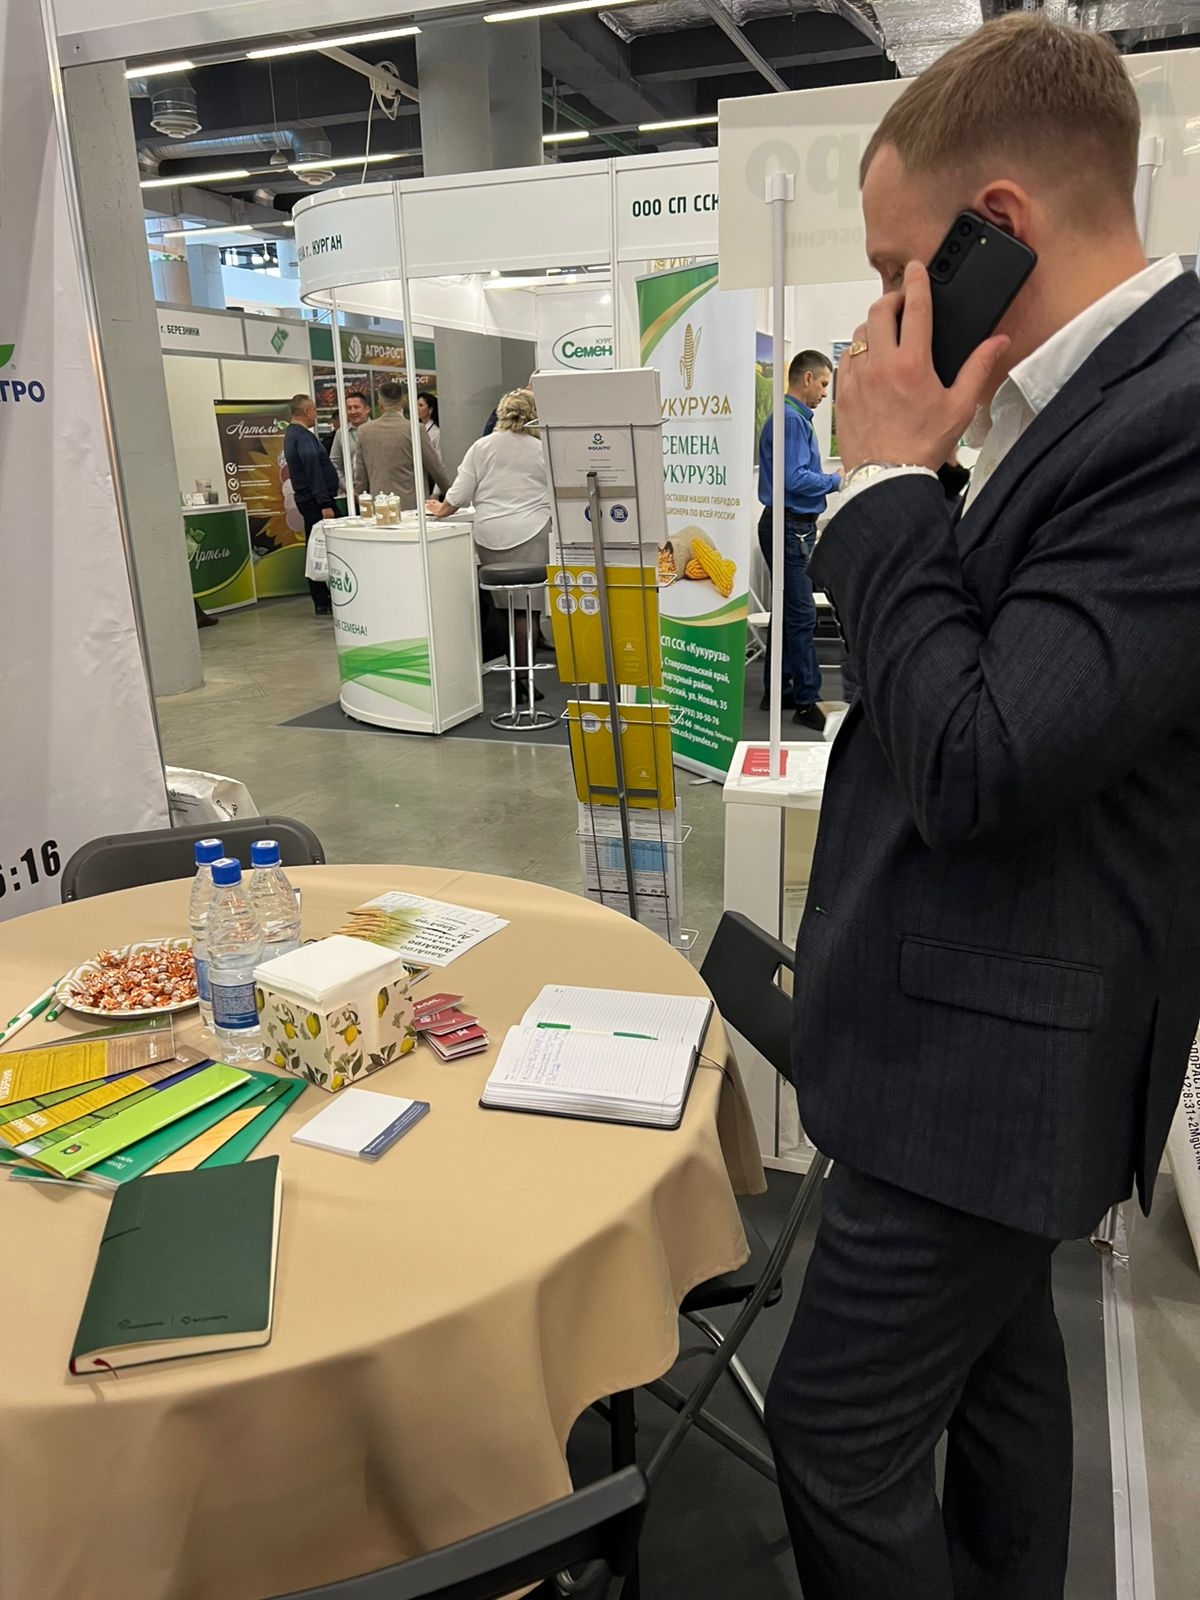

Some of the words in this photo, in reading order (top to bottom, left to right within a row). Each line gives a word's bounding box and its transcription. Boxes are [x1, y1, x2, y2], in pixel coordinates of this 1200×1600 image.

[632, 198, 662, 218] ООО
[668, 195, 687, 214] СП
[312, 234, 343, 256] КУРГАН
[562, 341, 613, 359] Семен
[596, 337, 612, 345] КУРГ
[365, 344, 404, 360] АГРО-РОСТ
[0, 380, 46, 403] ГРО
[661, 394, 732, 417] УКУРУЗА
[662, 435, 720, 455] СЕМЕНА
[663, 464, 727, 486] УКУРУЗЫ
[665, 493, 688, 503] ОСТАВКИ
[719, 699, 728, 711] 35
